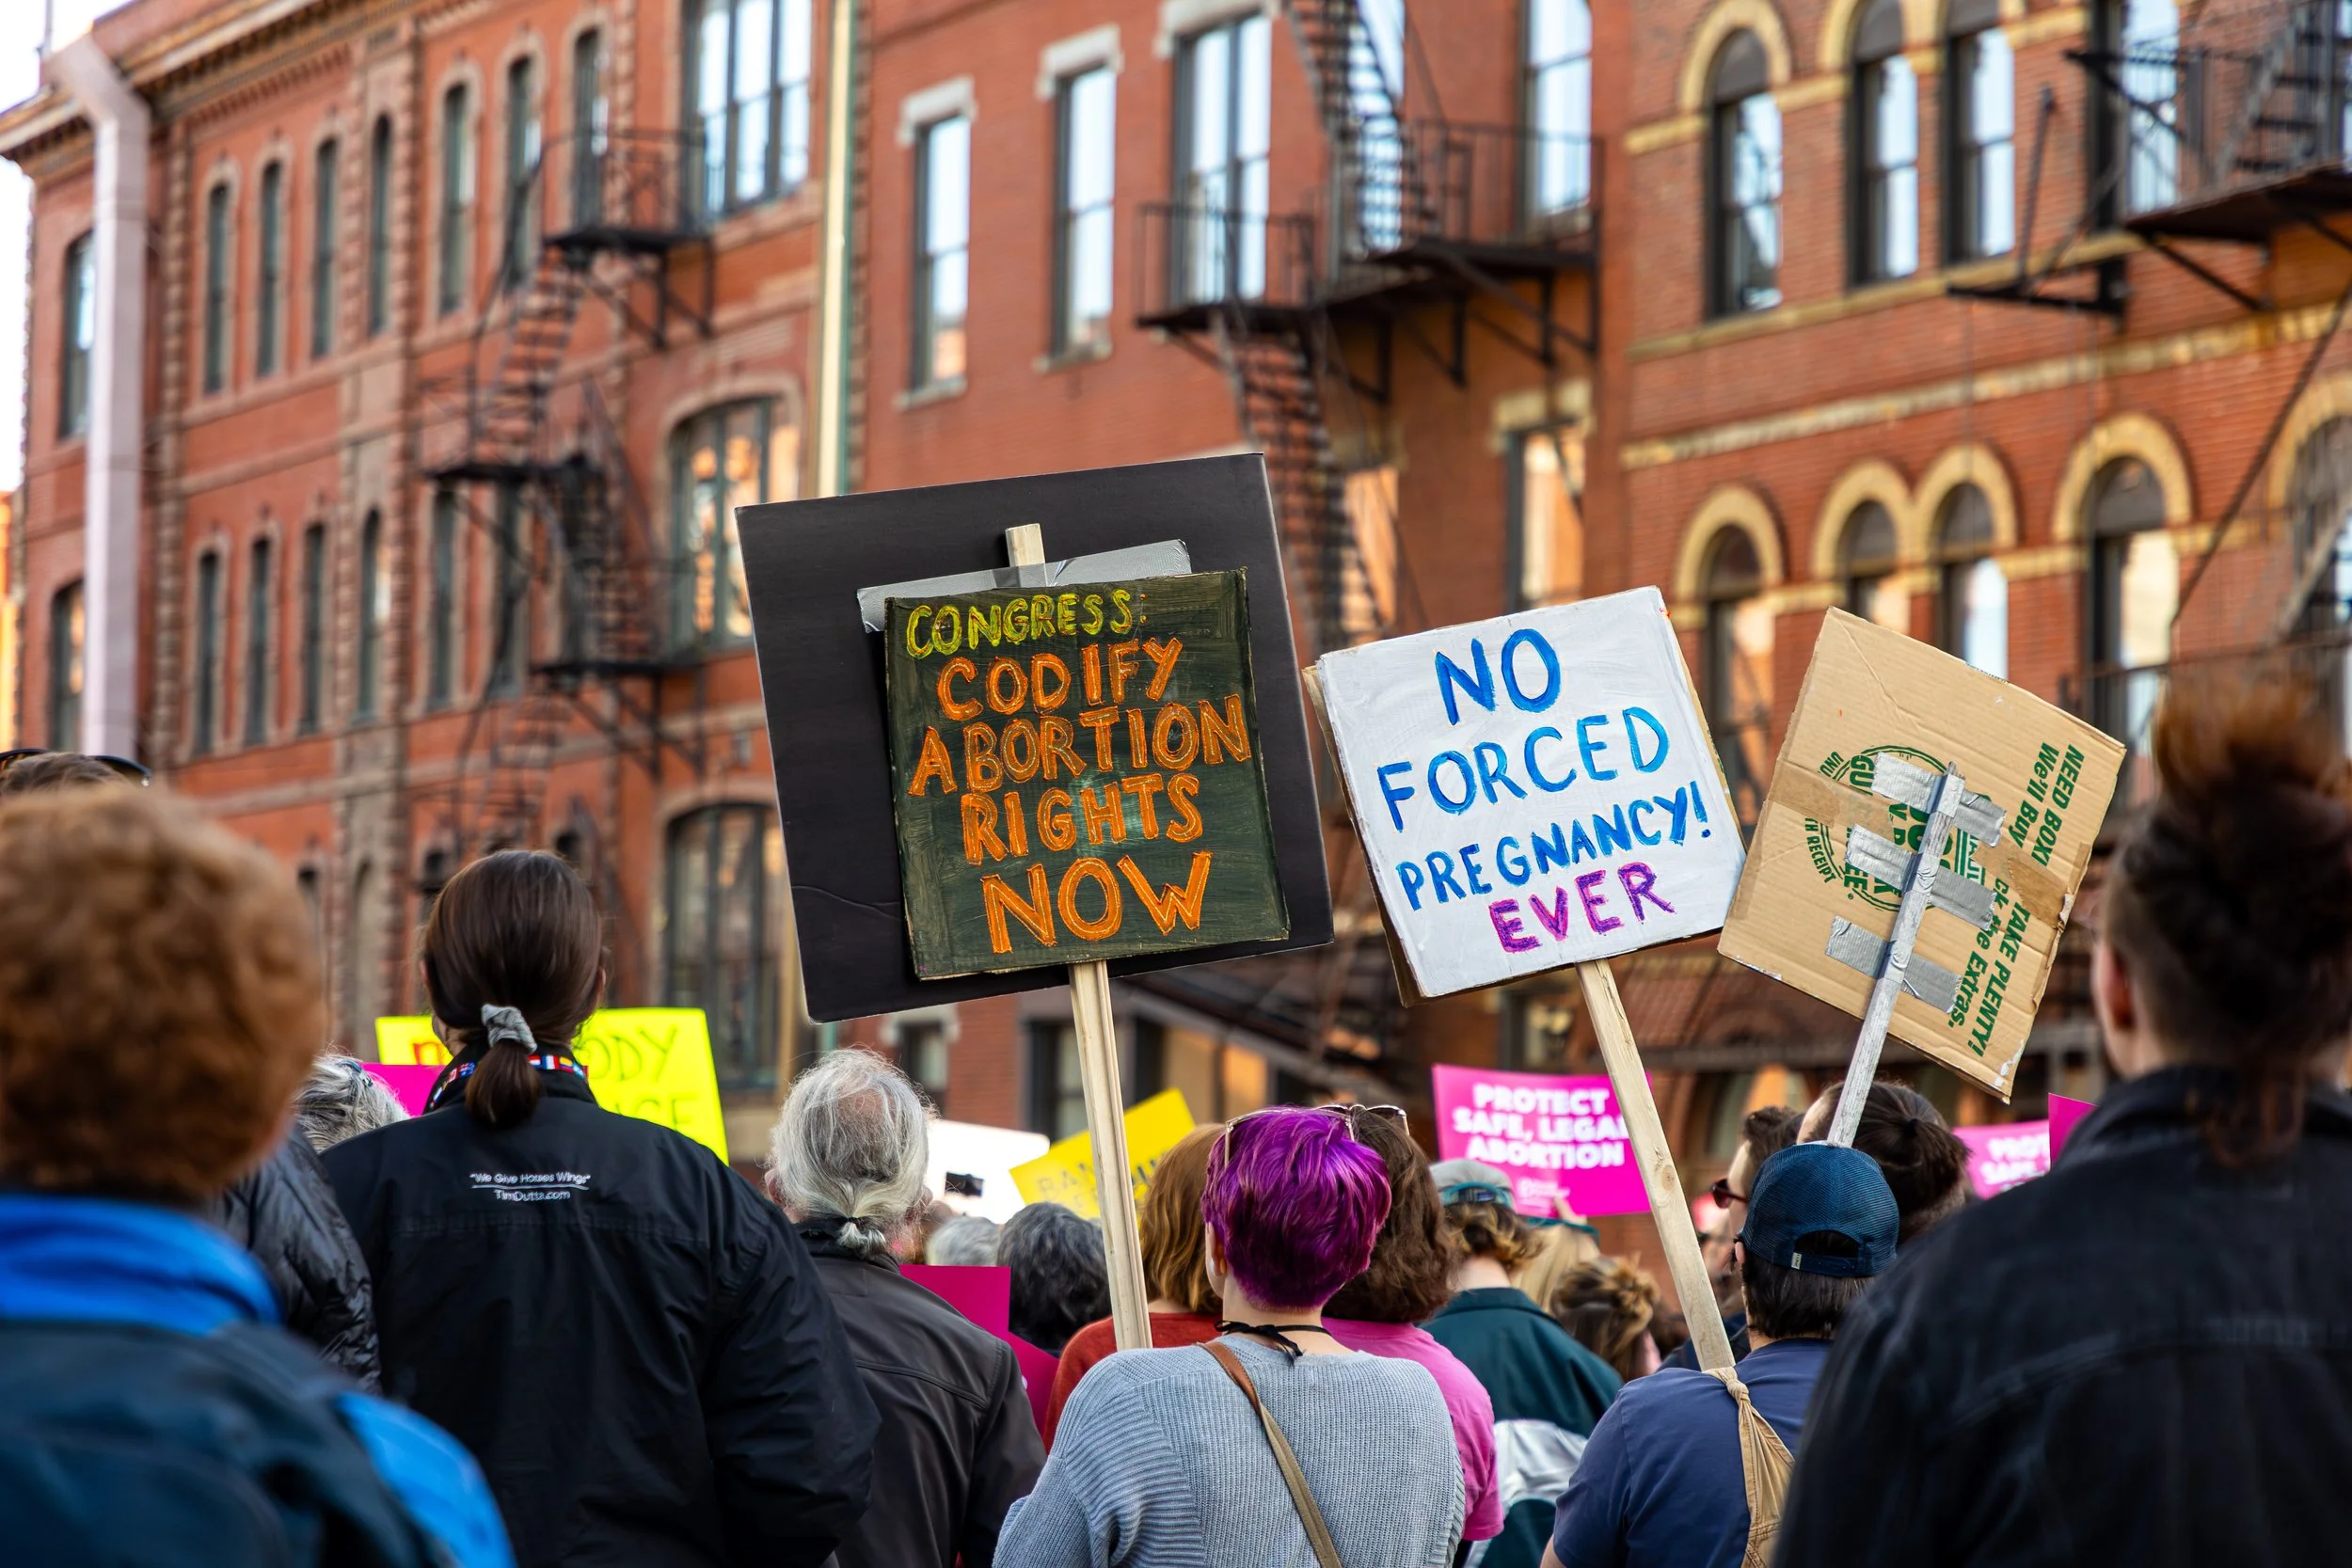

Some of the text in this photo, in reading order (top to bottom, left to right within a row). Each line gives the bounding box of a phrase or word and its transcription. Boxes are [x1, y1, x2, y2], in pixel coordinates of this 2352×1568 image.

[906, 589, 1147, 657] CONGRESS:
[937, 638, 1183, 721] CODIFY
[1435, 628, 1562, 727] NO
[908, 693, 1251, 798] ABORTION
[1377, 707, 1669, 832] FORCED
[2026, 742, 2059, 803] We'll
[2051, 744, 2085, 810] NEED
[961, 772, 1203, 866] RIGHTS
[1396, 780, 1710, 911] PREGNANCY!
[1806, 834, 1836, 883] RECEIPT
[2009, 800, 2039, 848] Buy
[981, 850, 1213, 954] NOW
[1488, 863, 1675, 953] EVER
[1947, 951, 1988, 1028] Extras.
[1967, 959, 2011, 1057] PLENTY!
[1452, 1106, 1534, 1141] SAFE,
[1471, 1083, 1611, 1117] PROTECT
[1465, 1135, 1626, 1170] ABORTION
